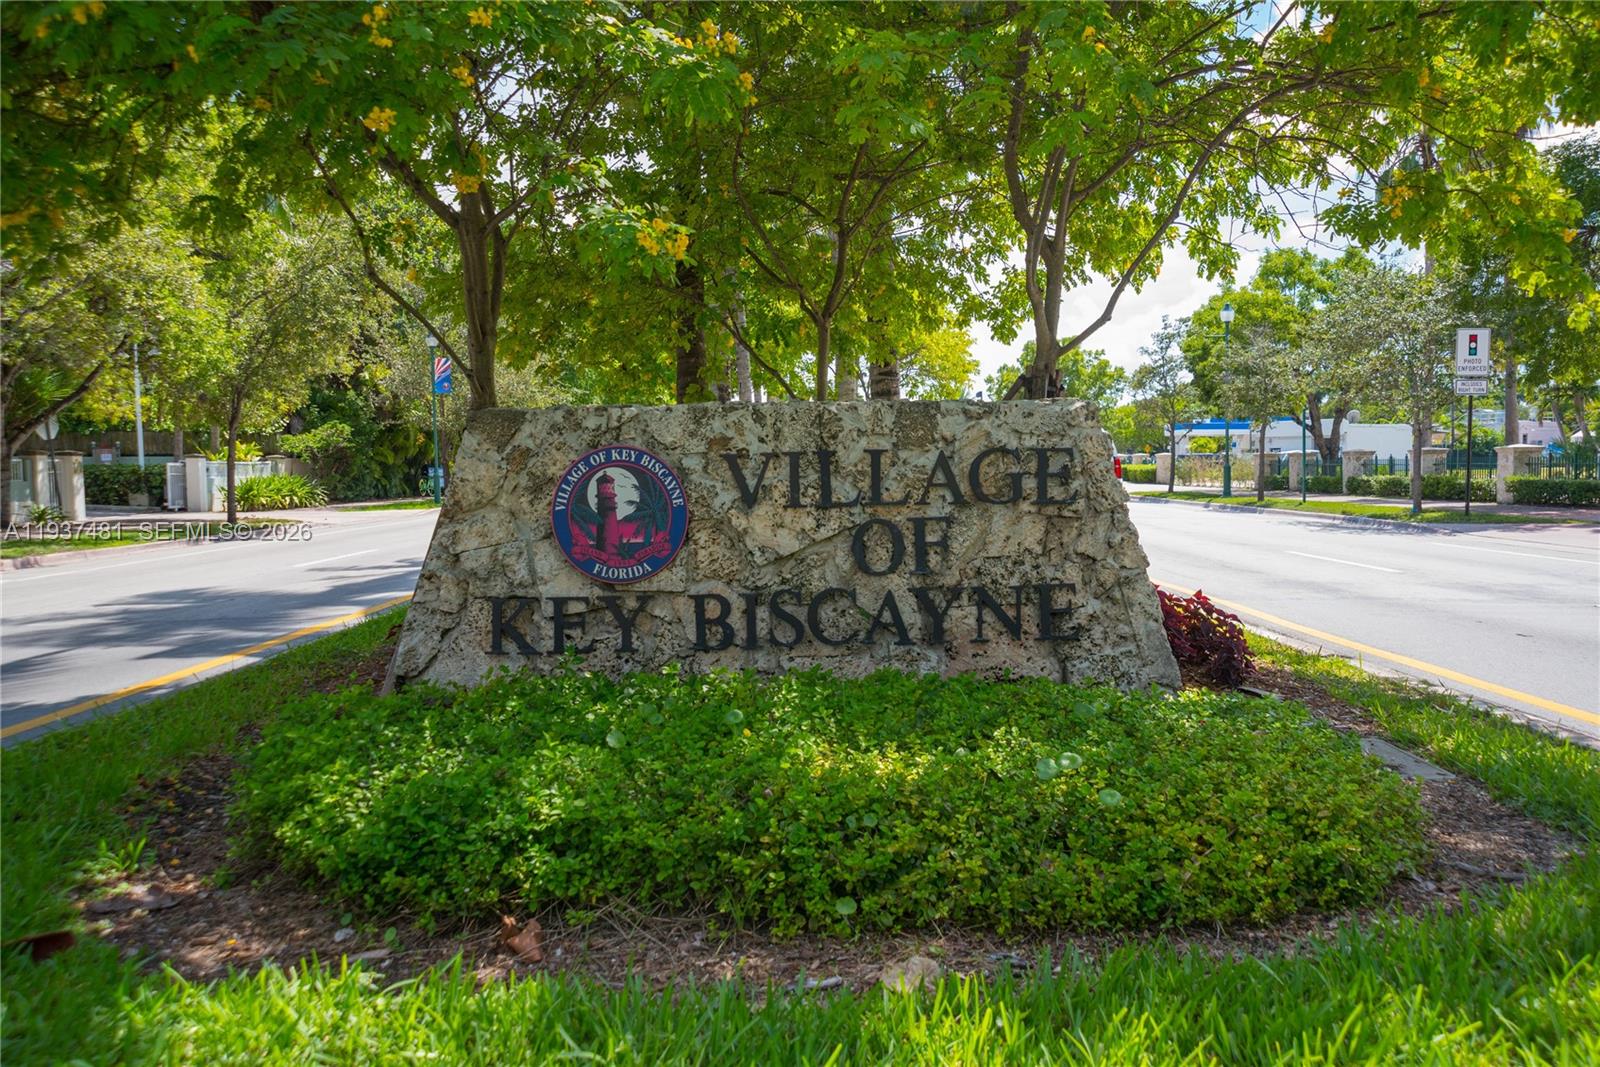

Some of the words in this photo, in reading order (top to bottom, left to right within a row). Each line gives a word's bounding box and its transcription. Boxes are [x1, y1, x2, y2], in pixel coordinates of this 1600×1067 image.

[554, 461, 589, 511] VILLAGE
[589, 450, 608, 466] OF
[611, 448, 639, 461] KEY
[640, 454, 685, 508] BISCAYNE
[722, 447, 1082, 510] VILLAGE
[592, 562, 653, 579] FLORIDA
[851, 515, 951, 577] OF
[485, 595, 655, 656] KEY
[687, 582, 1081, 653] BISCAYNE
